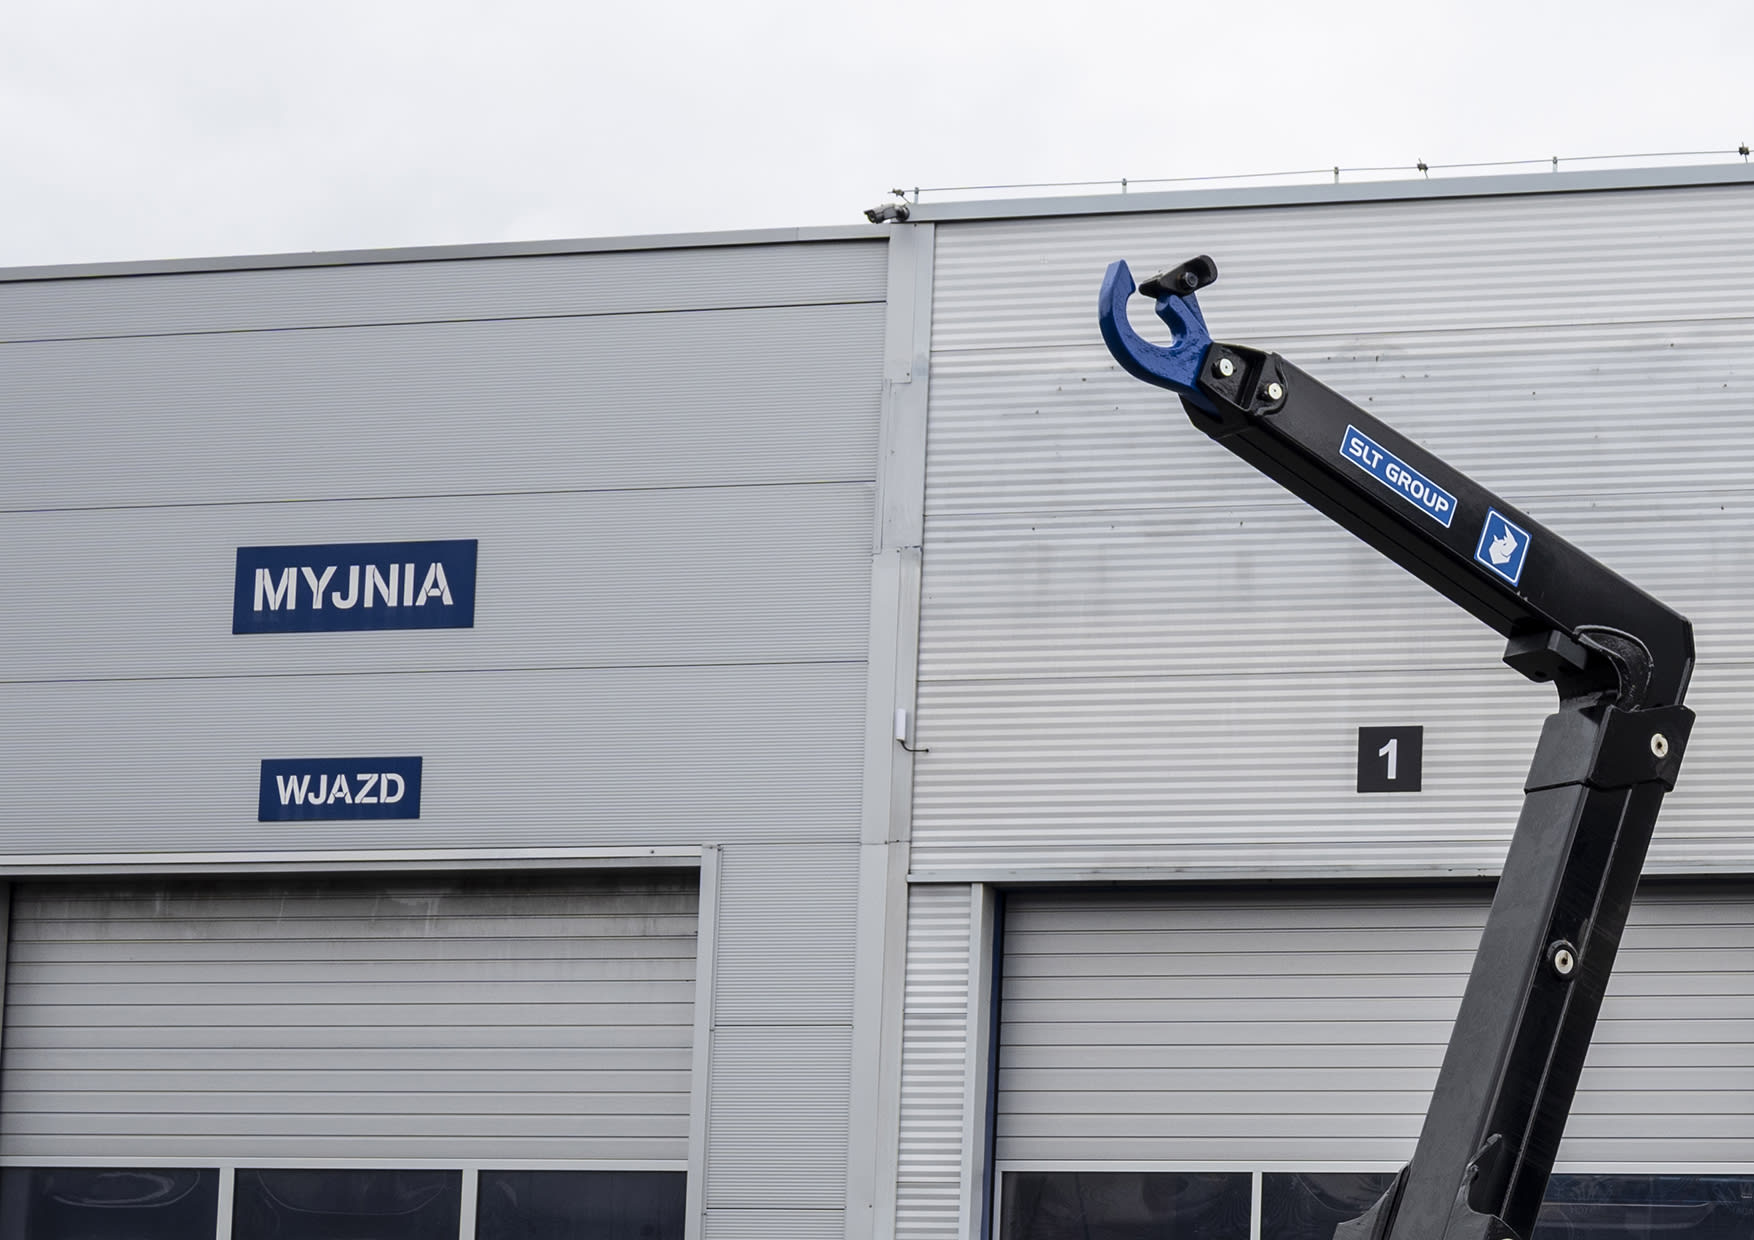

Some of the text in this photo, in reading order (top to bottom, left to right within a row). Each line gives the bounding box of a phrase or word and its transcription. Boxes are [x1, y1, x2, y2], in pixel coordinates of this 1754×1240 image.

[1348, 437, 1450, 513] SLT GROUP
[253, 562, 454, 611] MYJNIA
[1378, 738, 1398, 779] 1
[275, 772, 406, 805] WJAZD
